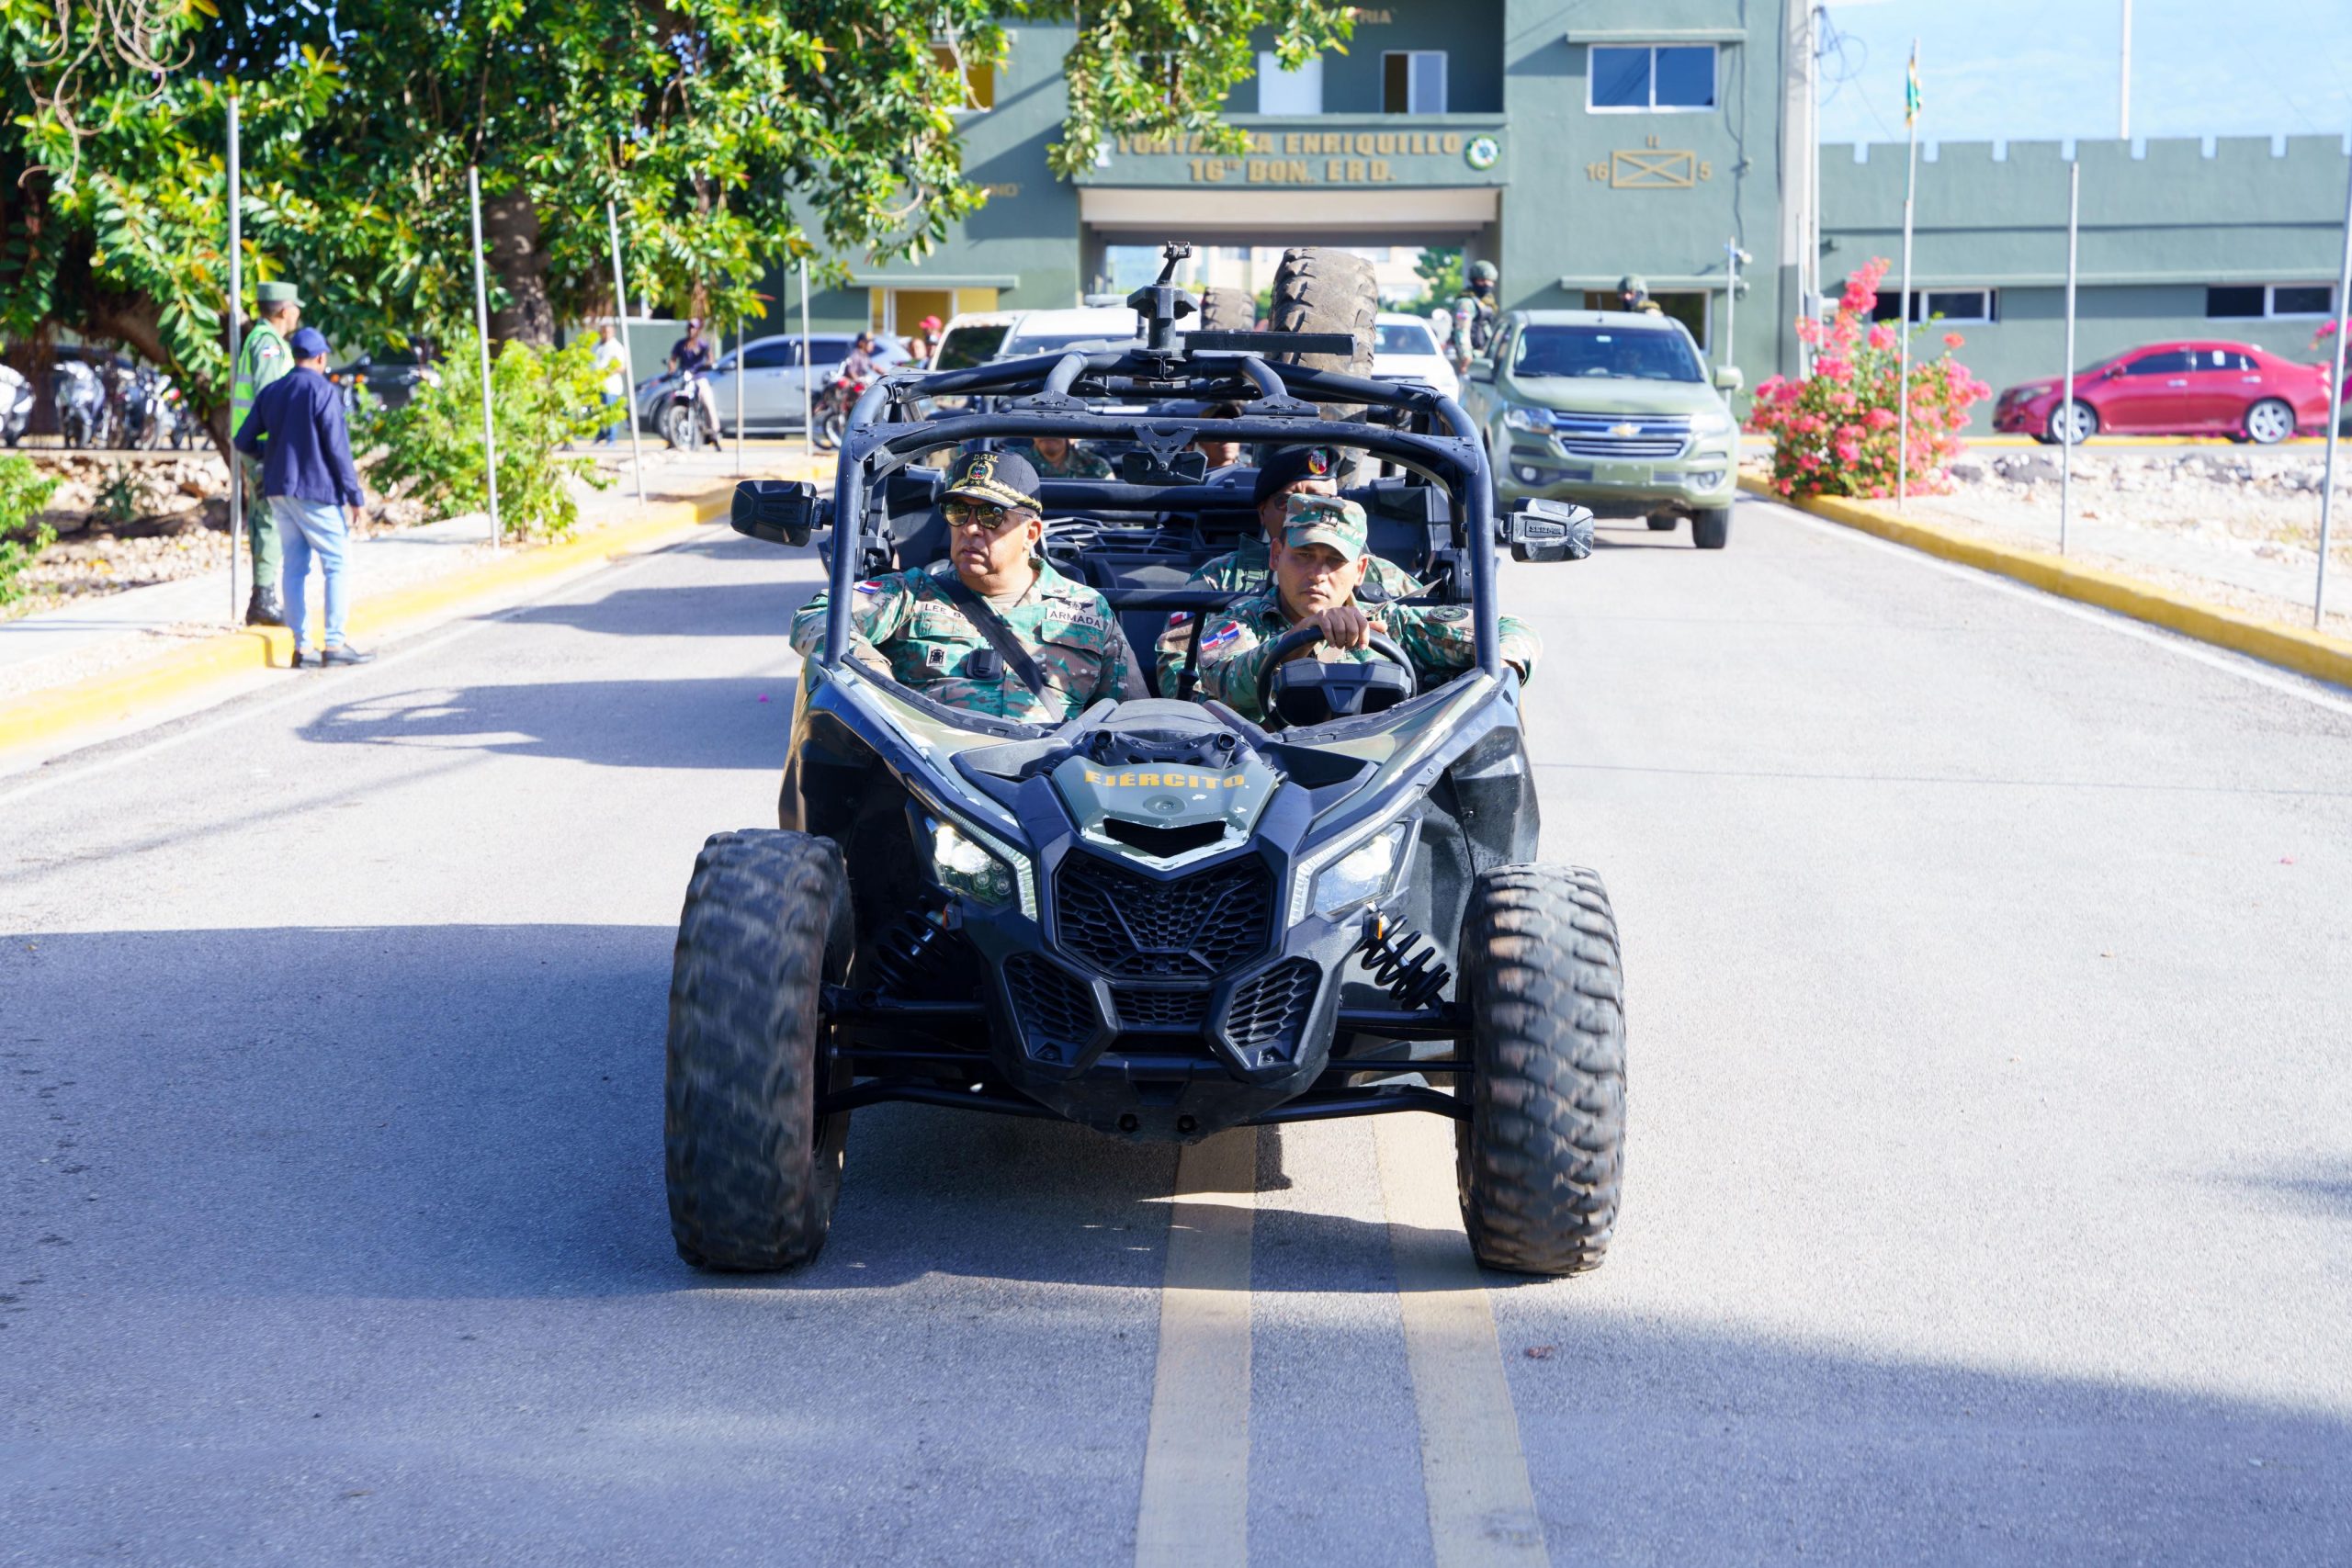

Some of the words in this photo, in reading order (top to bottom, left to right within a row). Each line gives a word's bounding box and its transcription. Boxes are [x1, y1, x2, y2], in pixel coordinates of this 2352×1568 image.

[1284, 131, 1461, 155] ENRIQUILLO
[924, 604, 947, 615] LEE
[1049, 610, 1101, 628] ARMADA
